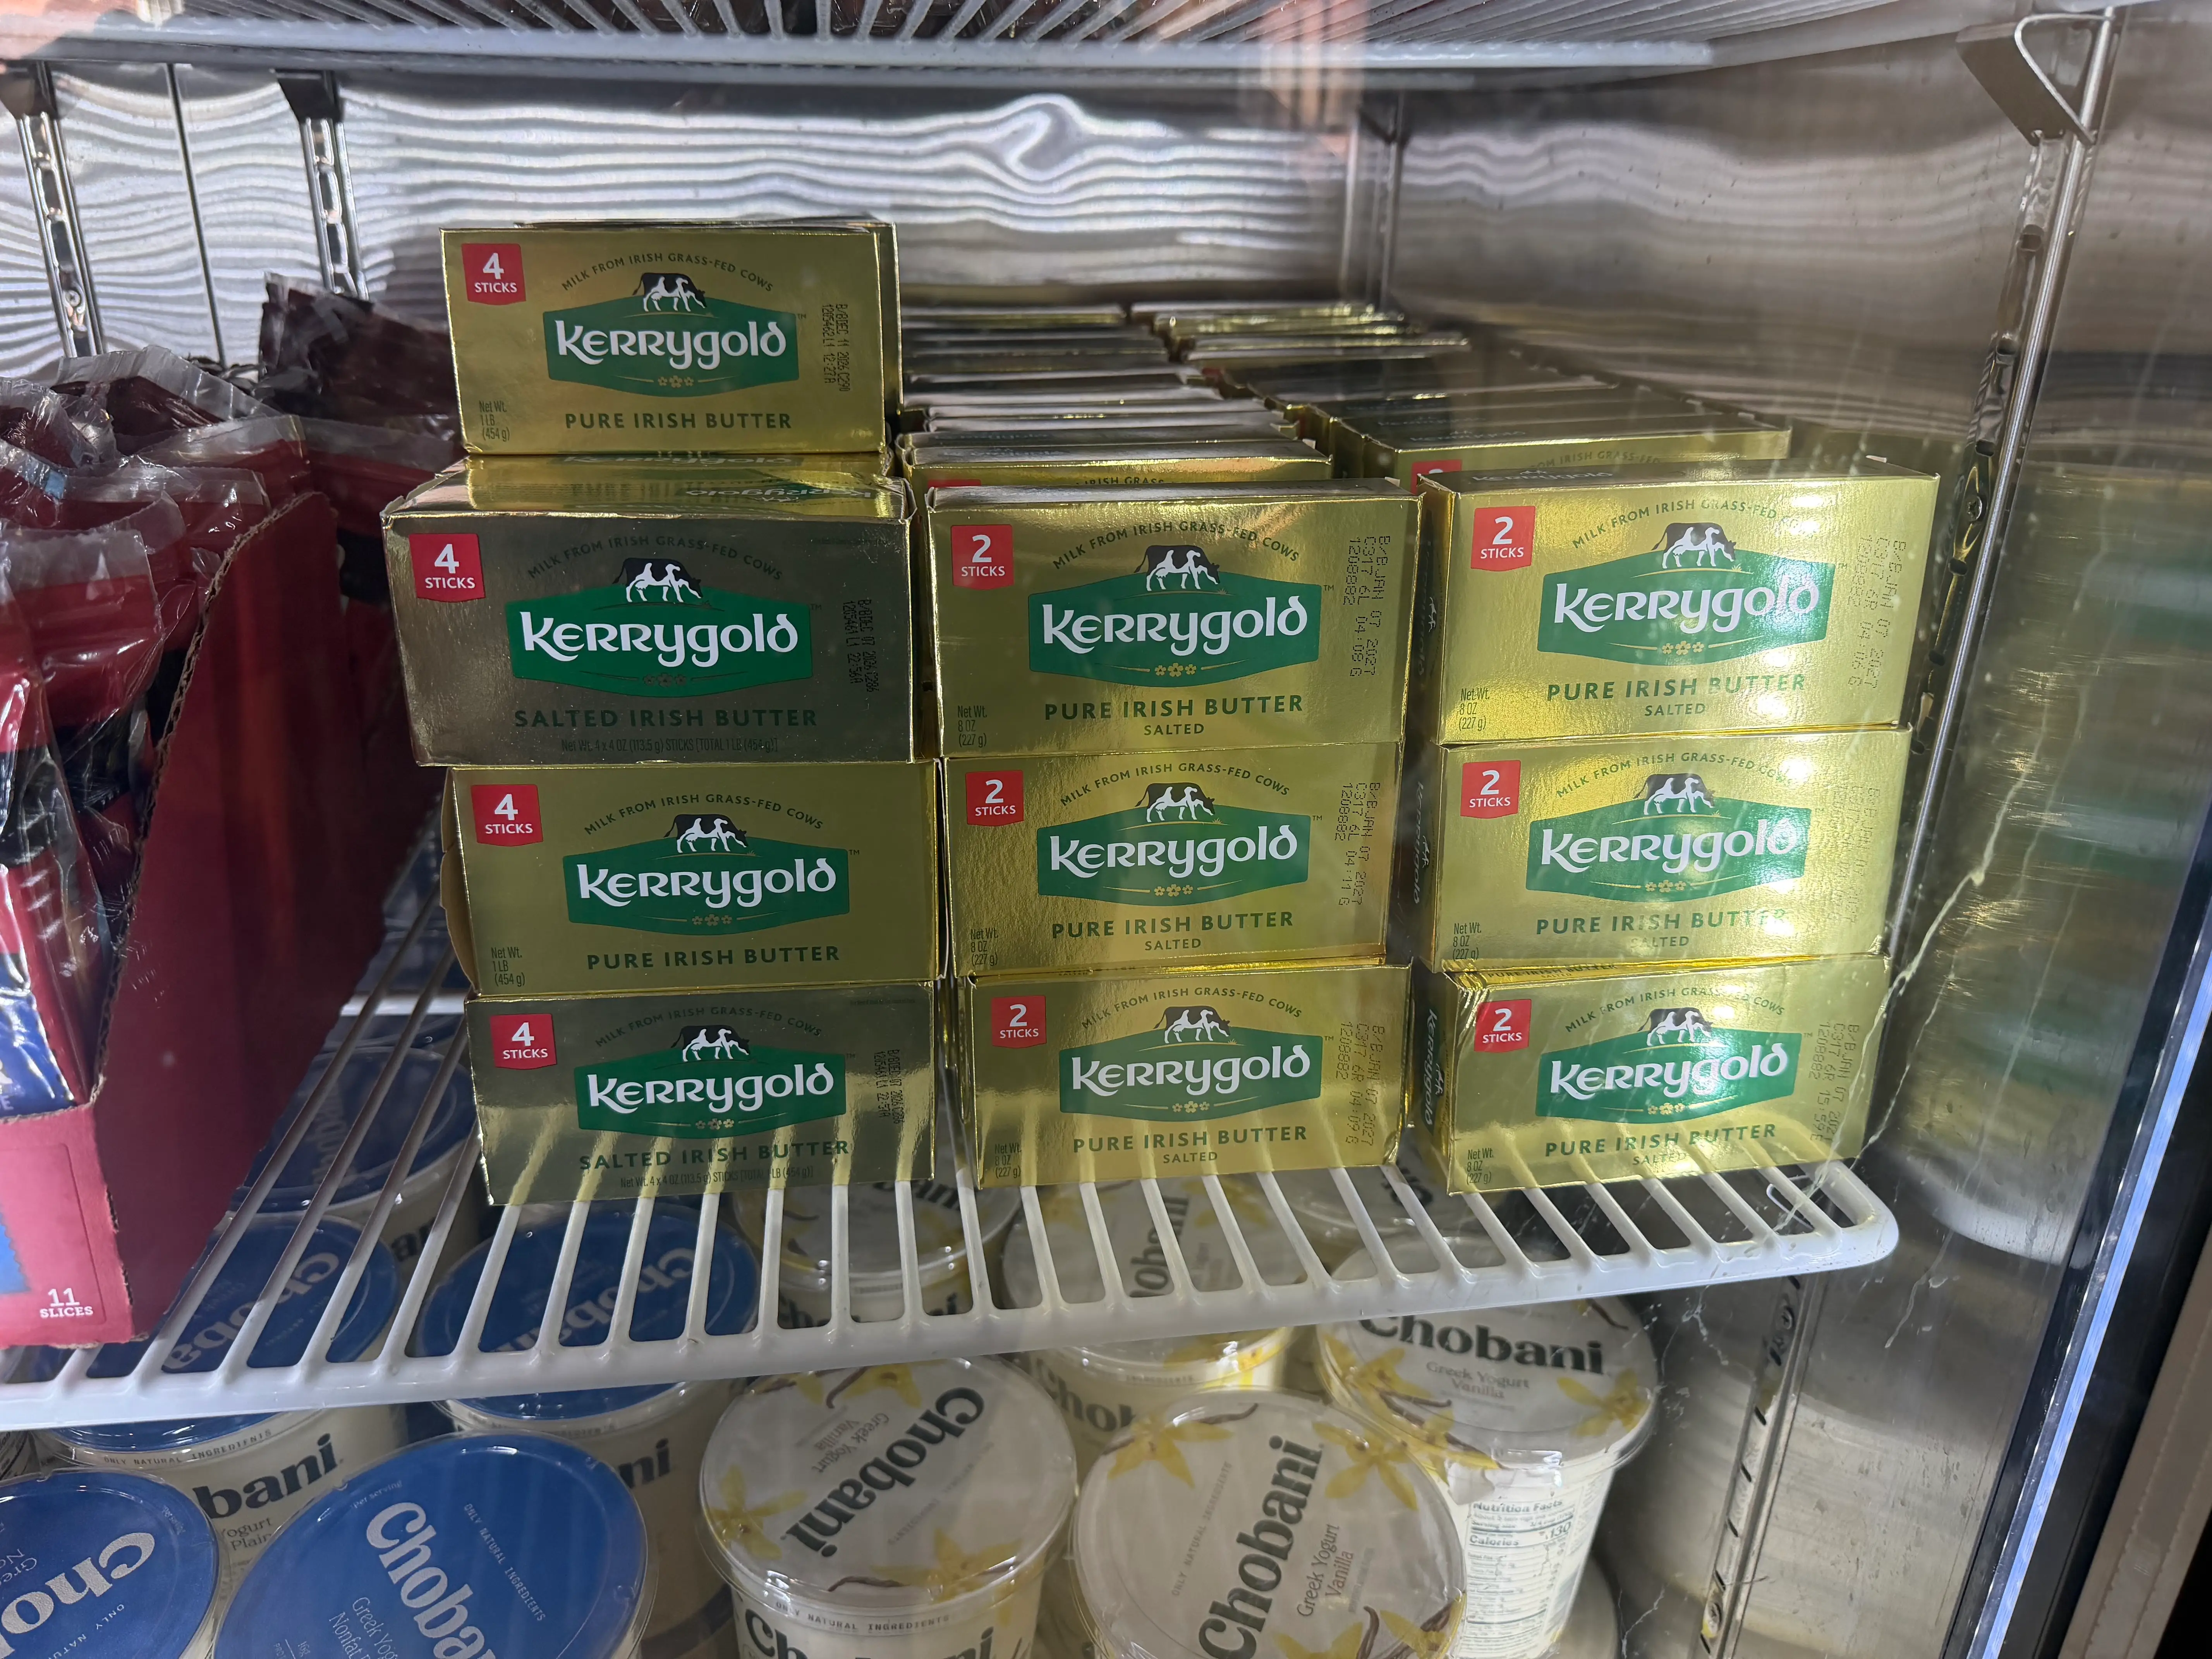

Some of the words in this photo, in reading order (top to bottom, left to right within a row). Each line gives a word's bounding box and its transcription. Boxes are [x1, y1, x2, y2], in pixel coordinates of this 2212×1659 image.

[483, 252, 504, 279] 4
[561, 272, 589, 291] MILK
[592, 257, 625, 274] FROM
[629, 253, 663, 264] IRISH
[668, 254, 736, 273] GRASS-FED
[740, 270, 774, 292] COWS
[474, 282, 517, 294] STICKS
[479, 400, 493, 413] Net
[495, 400, 507, 412] Wt.
[486, 414, 495, 426] LB
[566, 413, 625, 429] PURE
[634, 413, 697, 429] IRISH
[706, 413, 793, 429] BUTTER
[482, 427, 501, 441] (454
[503, 428, 510, 441] g)
[1493, 516, 1514, 545] 2
[433, 544, 460, 574] 4
[971, 535, 993, 563] 2
[1480, 547, 1524, 559] STICKS
[961, 566, 1005, 577] STICKS
[1343, 537, 1361, 605] 1208882
[425, 577, 476, 590] STICKS
[1460, 688, 1475, 701] Net
[1477, 688, 1490, 700] Wt.
[1547, 682, 1615, 702] PURE
[1625, 678, 1697, 699] IRISH
[1708, 674, 1805, 694] BUTTER
[515, 709, 618, 727] SALTED
[629, 709, 704, 726] IRISH
[716, 709, 817, 726] BUTTER
[1045, 703, 1111, 721] PURE
[1124, 699, 1193, 717] IRISH
[1205, 695, 1303, 715] BUTTER
[1467, 703, 1477, 714] OZ
[1645, 703, 1706, 716] SALTED
[1144, 723, 1204, 736] SALTED
[1459, 716, 1476, 731] (227
[1478, 718, 1486, 731] g)
[985, 780, 1004, 804] 2
[1060, 790, 1091, 807] MILK
[1095, 772, 1132, 790] FROM
[1135, 763, 1173, 776] IRISH
[1178, 763, 1251, 780] GRASS-FED
[1255, 775, 1290, 796] COWS
[1482, 770, 1500, 795] 2
[495, 793, 519, 821] 4
[975, 805, 1016, 816] STICKS
[1334, 783, 1353, 841] 1208882
[1469, 797, 1511, 807] STICKS
[584, 817, 616, 835] MILK
[620, 800, 656, 817] FROM
[661, 794, 700, 805] IRISH
[706, 794, 781, 811] GRASS-FED
[786, 808, 823, 829] COWS
[485, 823, 532, 835] STICKS
[1052, 921, 1113, 939] PURE
[1125, 917, 1191, 935] IRISH
[1202, 911, 1293, 930] BUTTER
[1536, 918, 1600, 935] PURE
[1612, 914, 1681, 932] IRISH
[491, 947, 505, 959] Net
[507, 946, 522, 958] Wt.
[1145, 938, 1202, 951] SALTED
[498, 961, 508, 971] LB
[587, 952, 653, 970] PURE
[665, 950, 733, 966] IRISH
[745, 946, 840, 963] BUTTER
[495, 972, 515, 986] (454
[517, 973, 525, 986] g)
[1009, 1004, 1028, 1027] 2
[1494, 1008, 1511, 1032] 2
[512, 1022, 534, 1046] 4
[1000, 1028, 1039, 1038] STICKS
[1482, 1032, 1522, 1043] STICKS
[503, 1049, 548, 1060] STICKS
[1073, 1135, 1133, 1153] PURE
[1144, 1132, 1207, 1149] IRISH
[1218, 1126, 1307, 1144] BUTTER
[1546, 1139, 1605, 1157] PURE
[1616, 1133, 1679, 1151] IRISH
[1690, 1124, 1776, 1144] BUTTER
[580, 1152, 671, 1170] SALTED
[682, 1147, 747, 1164] IRISH
[758, 1140, 849, 1159] BUTTER
[1163, 1152, 1218, 1163] SALTED
[47, 1288, 79, 1307] 11
[40, 1305, 94, 1319] SLICES
[192, 1433, 337, 1519] bani
[786, 1386, 984, 1557] Chobani
[1198, 1435, 1322, 1659] Chobani
[464, 1503, 483, 1525] ONLY
[479, 1528, 506, 1564] NATURAL
[505, 1567, 546, 1621] INGREDIENTS
[1297, 1573, 1324, 1617] Greek
[1314, 1524, 1339, 1569] Yogurt
[366, 1502, 496, 1659] Choba
[1326, 1550, 1353, 1598] Vanilla
[352, 1597, 385, 1638] Greek
[808, 1614, 856, 1630] NATURAL
